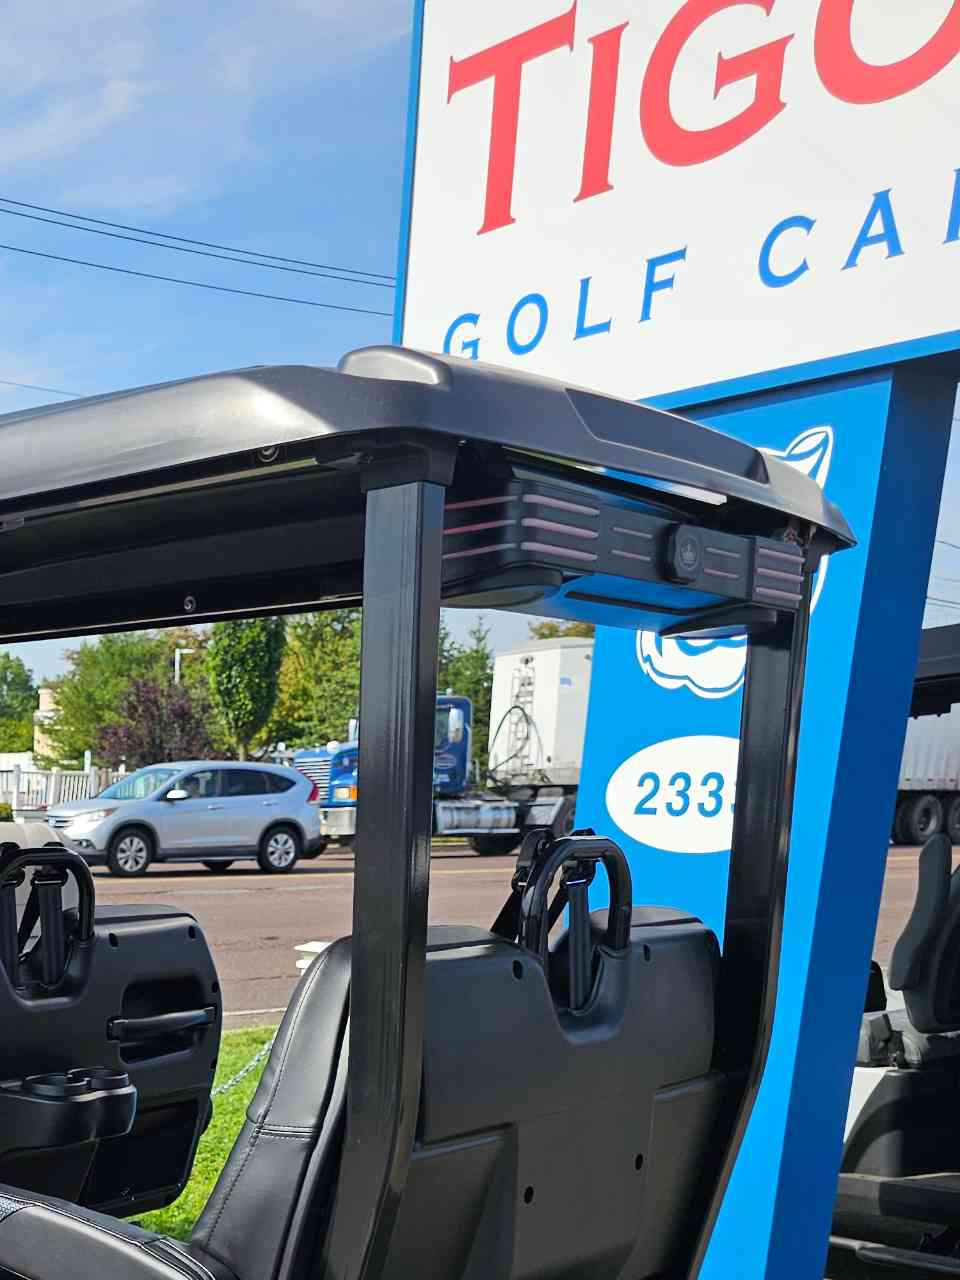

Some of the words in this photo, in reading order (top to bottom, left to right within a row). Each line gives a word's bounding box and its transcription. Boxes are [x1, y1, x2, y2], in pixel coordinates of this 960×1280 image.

[444, 246, 687, 361] GOLF
[758, 168, 960, 288] CA
[633, 771, 735, 818] 233
